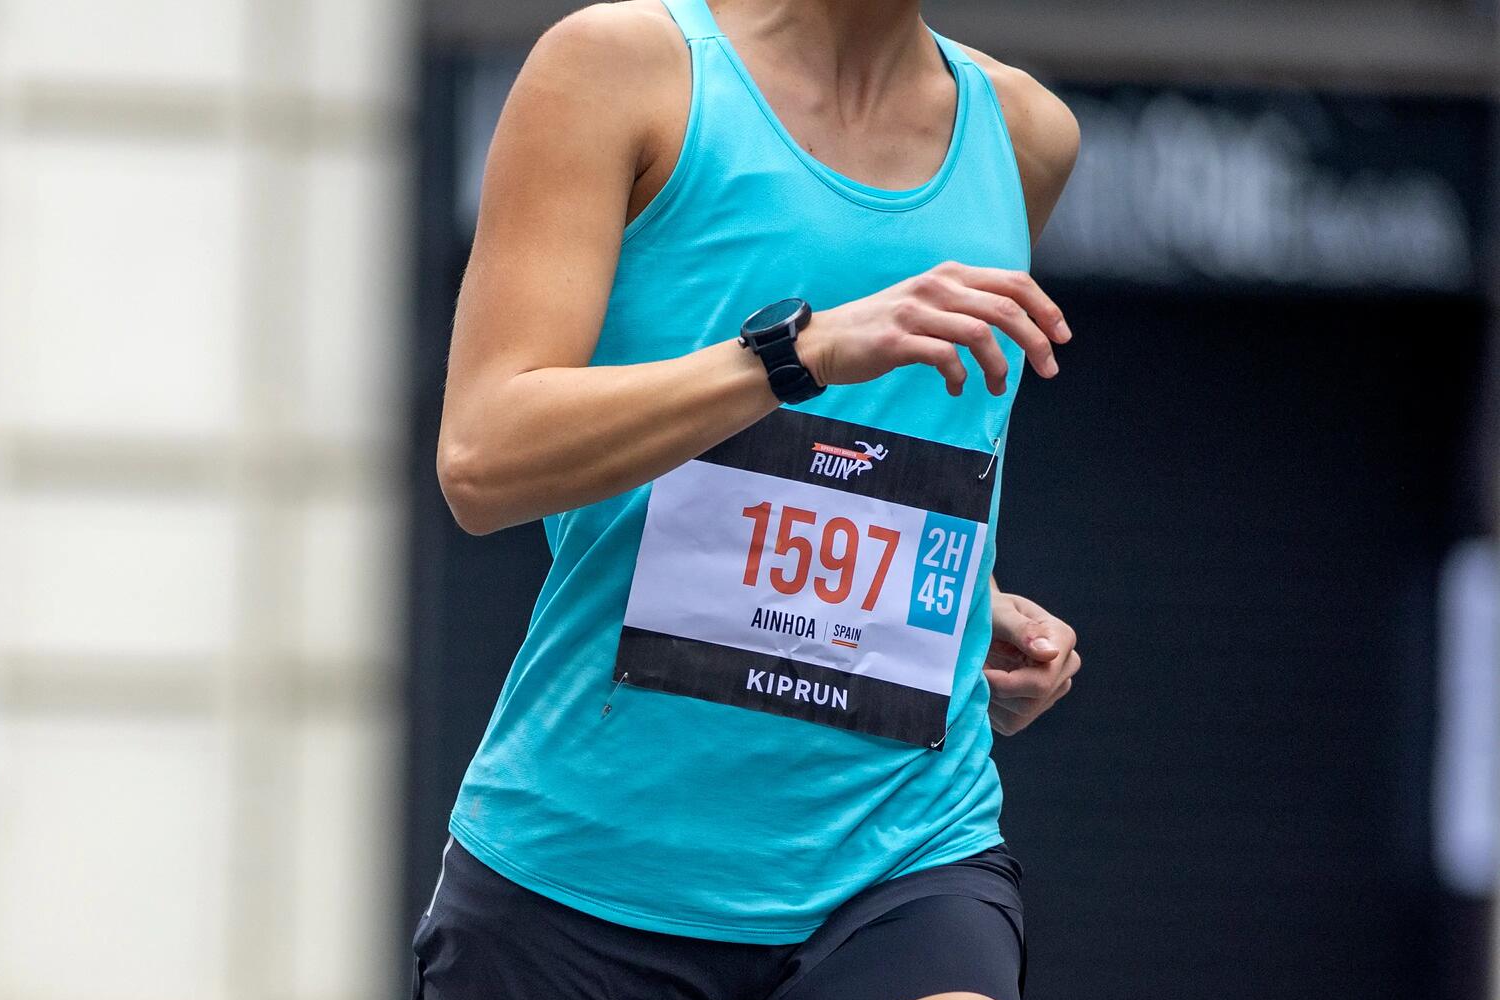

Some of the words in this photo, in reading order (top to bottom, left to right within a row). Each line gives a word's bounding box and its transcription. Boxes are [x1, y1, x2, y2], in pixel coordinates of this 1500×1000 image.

[809, 452, 854, 481] RUN
[742, 501, 900, 612] 1597
[922, 527, 968, 572] 2H
[917, 573, 955, 616] 45
[750, 608, 816, 640] AINHOA
[833, 623, 862, 642] SPAIN
[746, 669, 848, 711] KIPRUN
